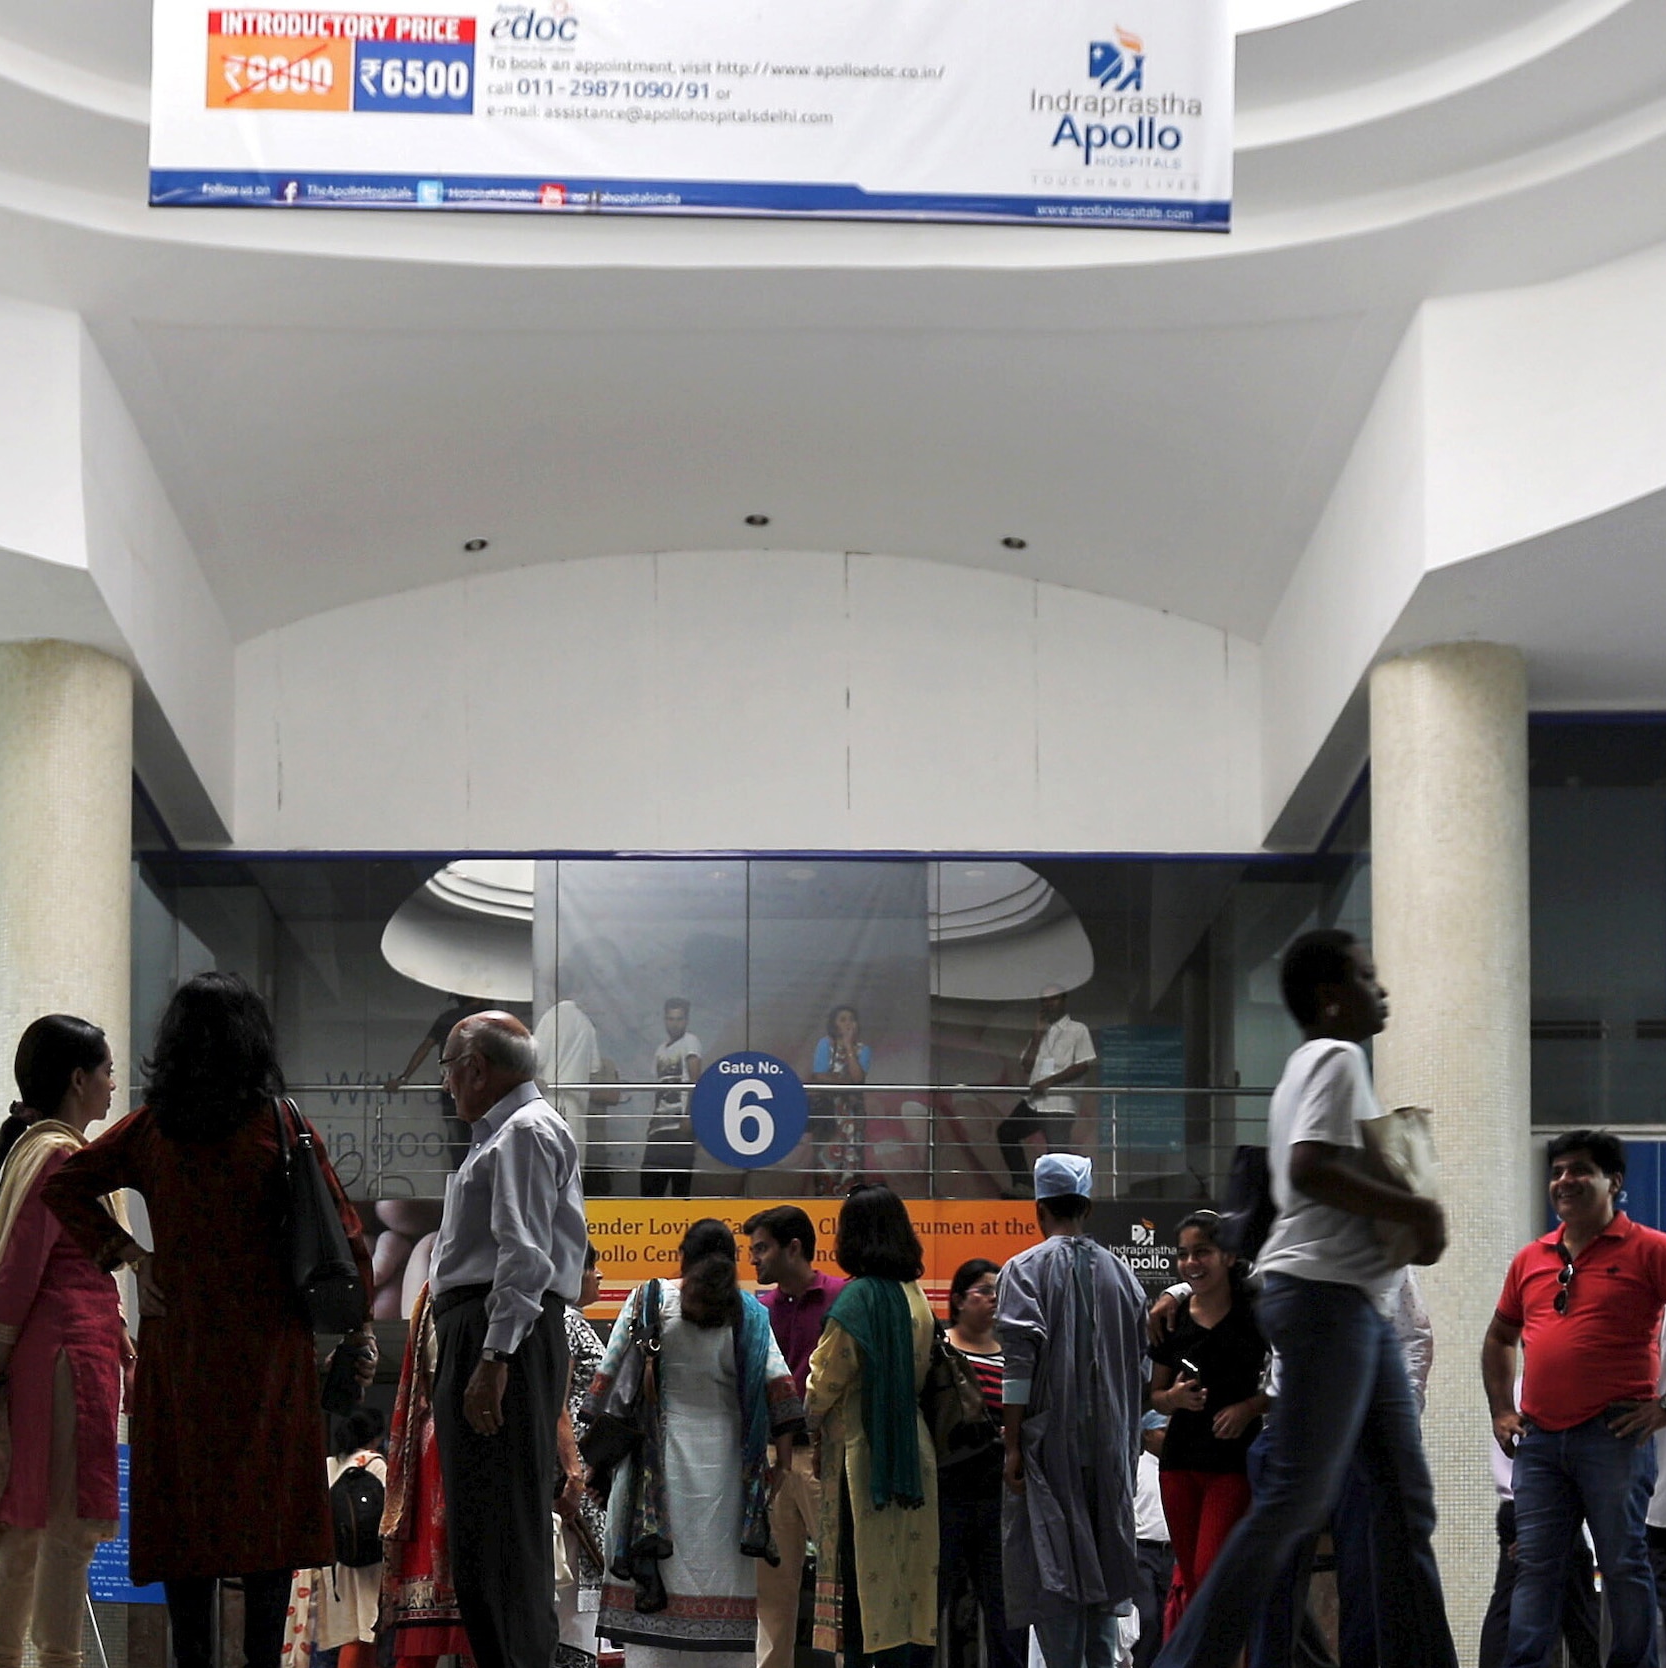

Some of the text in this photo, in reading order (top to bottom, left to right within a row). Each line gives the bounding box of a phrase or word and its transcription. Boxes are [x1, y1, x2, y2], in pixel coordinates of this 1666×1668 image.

[220, 12, 460, 41] INTRODUCTORY PRICE
[490, 8, 579, 41] edoc
[488, 56, 506, 70] To
[510, 57, 546, 70] book
[552, 61, 570, 71] an
[682, 61, 711, 74] visit
[360, 58, 470, 98] ₹6500
[487, 81, 512, 95] call
[716, 89, 732, 100] or
[1030, 88, 1202, 118] Indraprastha
[1052, 113, 1182, 166] Apollo
[1095, 155, 1183, 169] HOSPITALS
[1030, 174, 1201, 192] TOUCHING LIVES
[719, 1060, 784, 1074] Gate No.
[723, 1078, 775, 1155] 6
[327, 1123, 445, 1167] in goo
[649, 1217, 689, 1235] Lovi
[914, 1217, 1037, 1235] cumen at the
[592, 1245, 637, 1267] pollo
[643, 1245, 682, 1262] Cen
[1109, 1244, 1178, 1256] Indraprastha
[1120, 1254, 1170, 1273] Apollo
